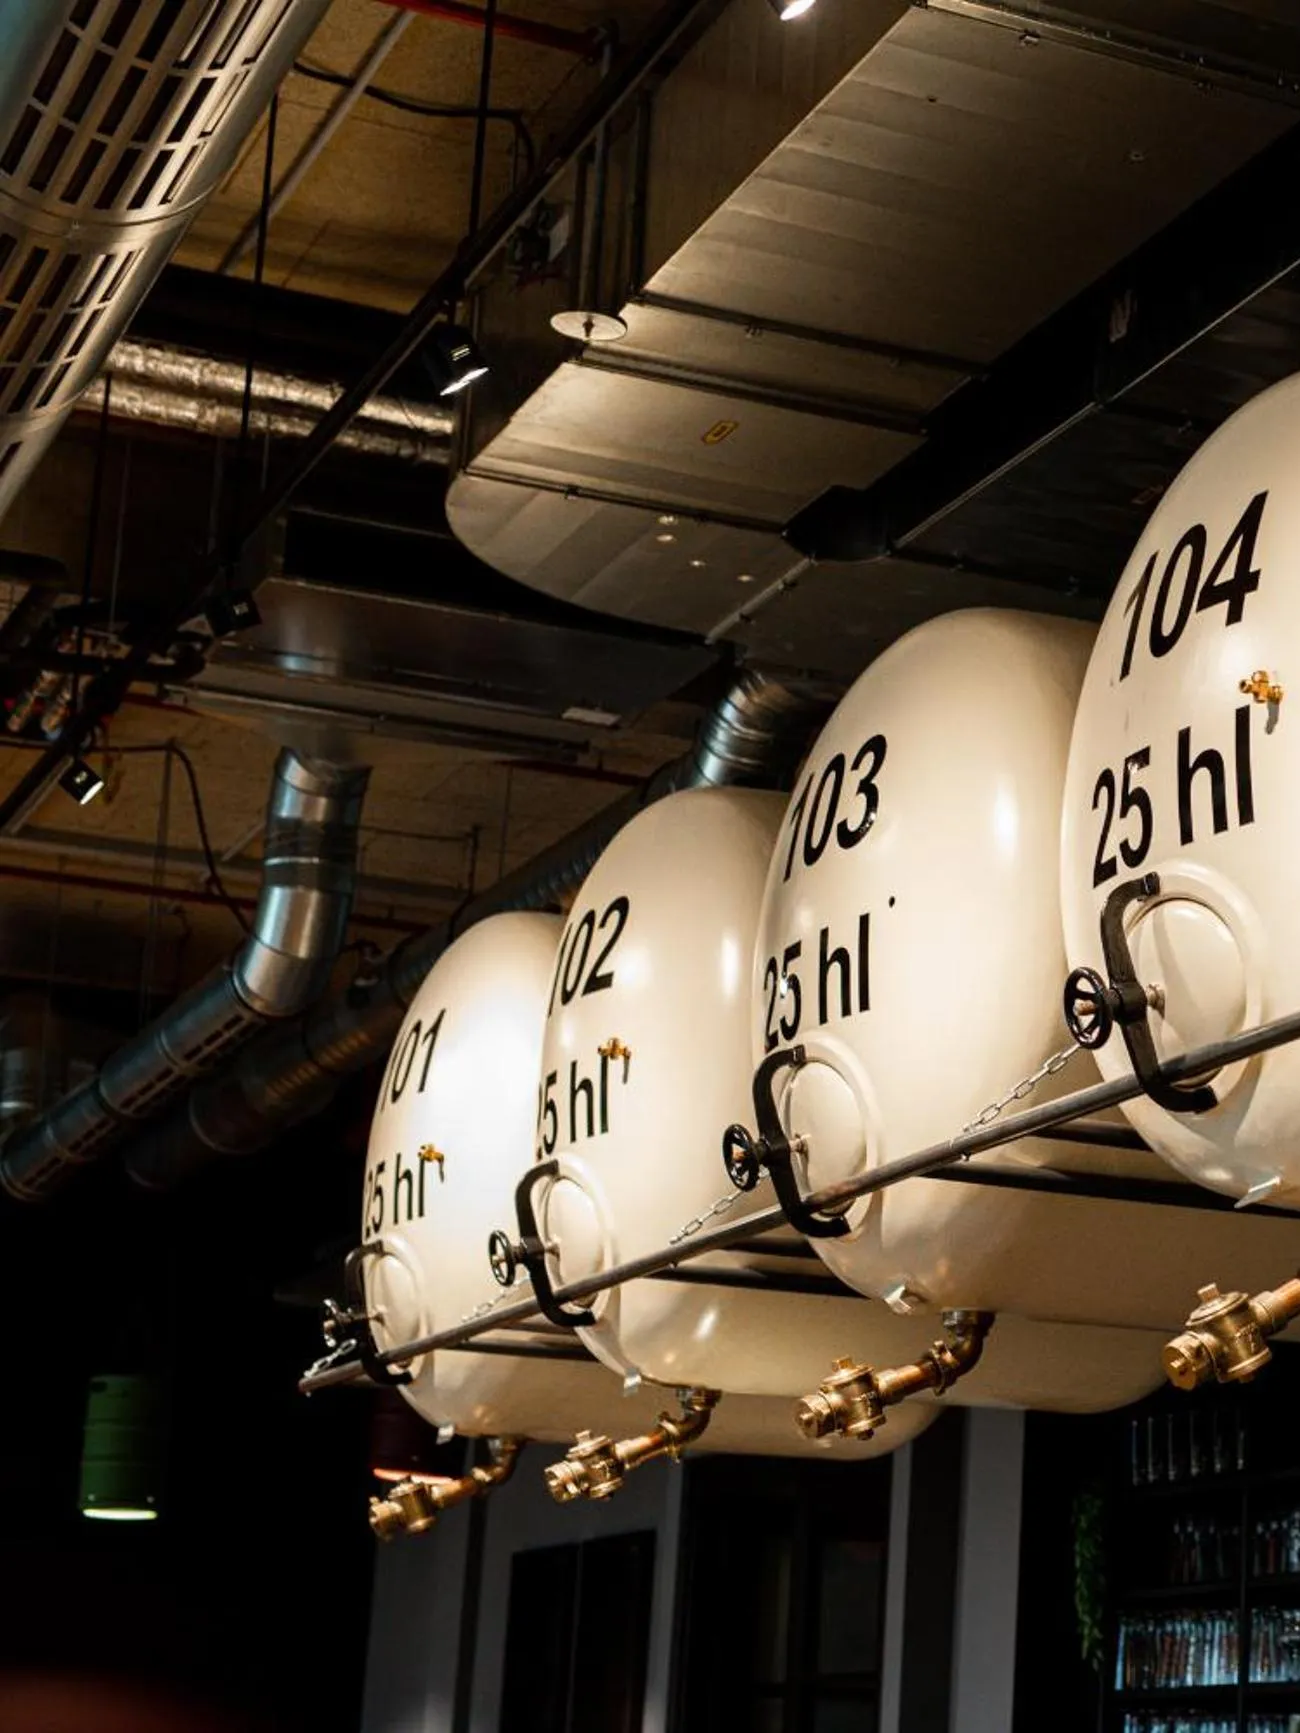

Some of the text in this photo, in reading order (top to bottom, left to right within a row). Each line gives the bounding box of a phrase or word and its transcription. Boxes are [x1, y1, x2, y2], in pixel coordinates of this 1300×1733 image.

[1119, 490, 1269, 682] 104
[783, 734, 888, 883] 103
[1092, 704, 1254, 888] 25 hl
[548, 896, 630, 1018] 102
[763, 912, 871, 1053] 25 hl
[569, 1056, 610, 1143] hl
[393, 1152, 425, 1226] hl
